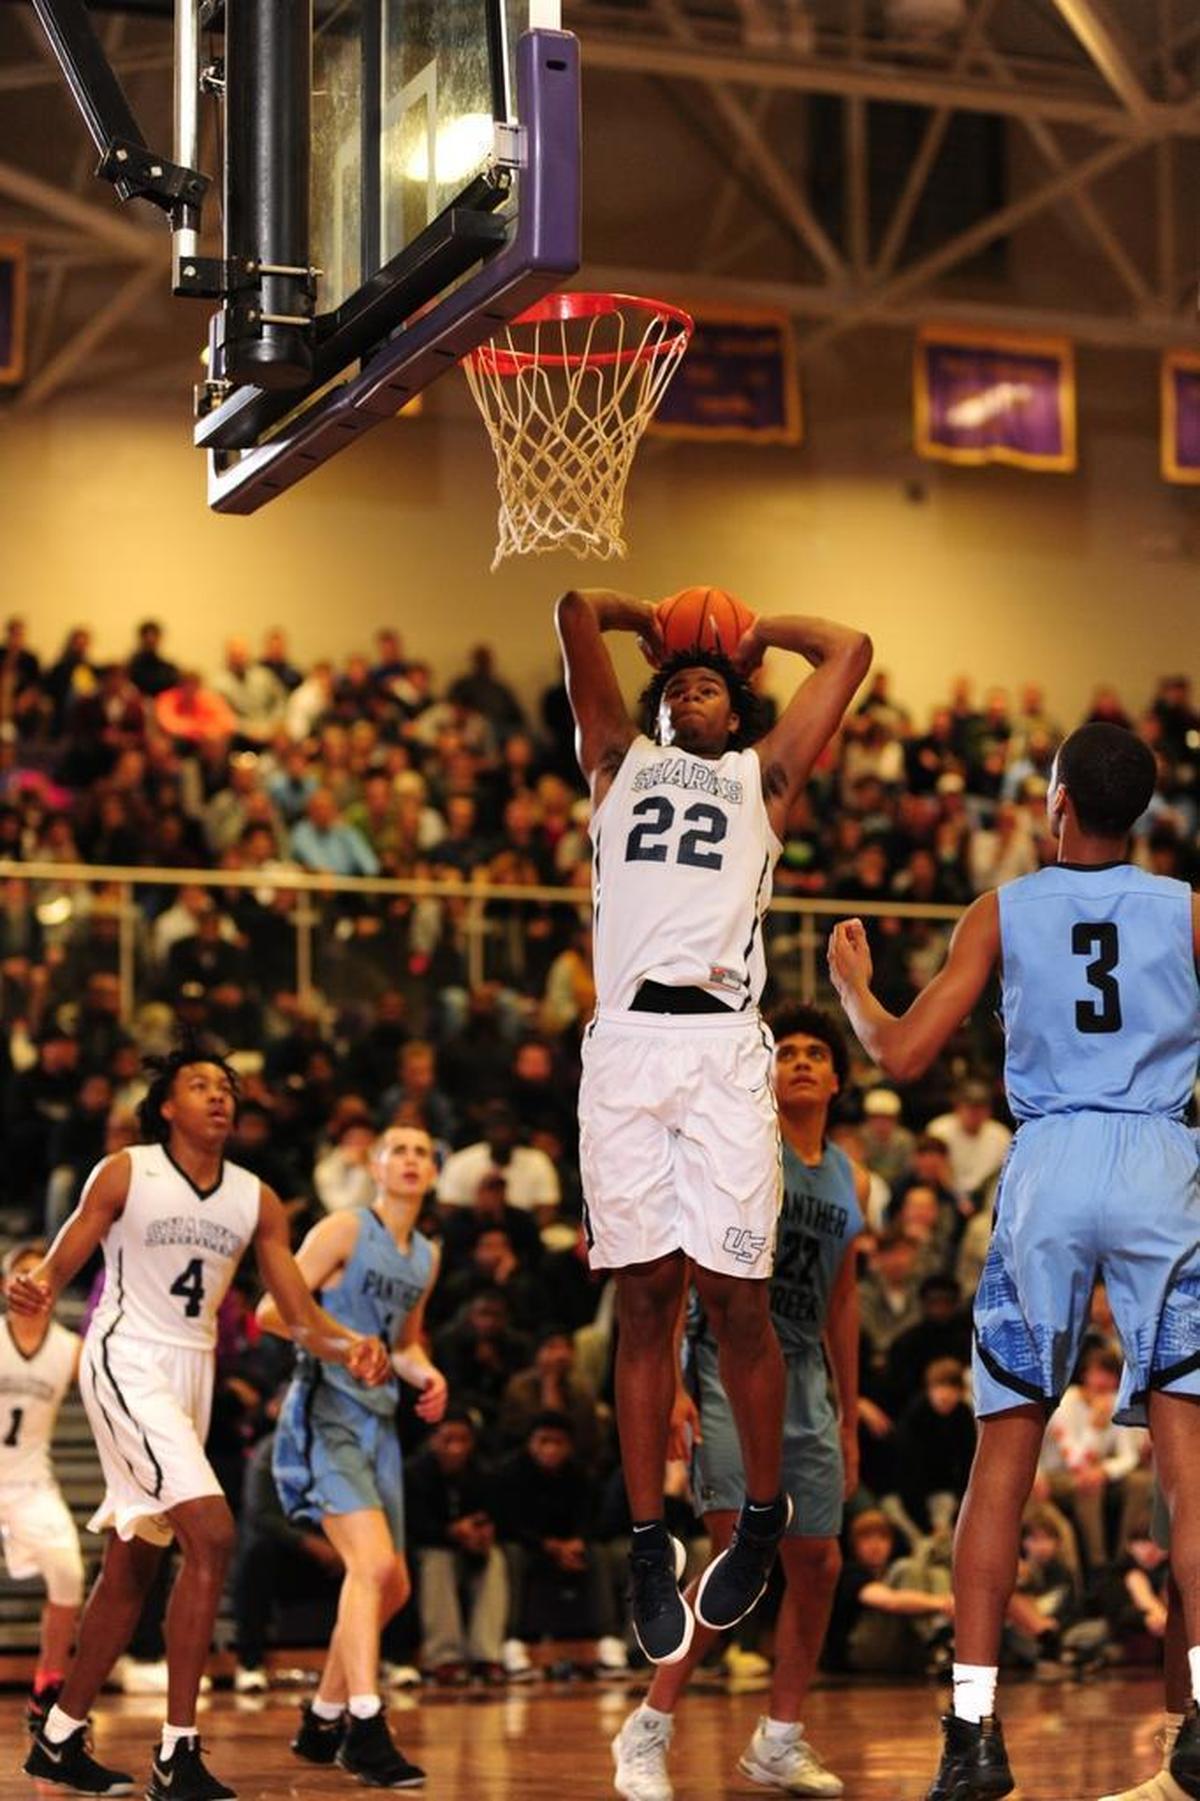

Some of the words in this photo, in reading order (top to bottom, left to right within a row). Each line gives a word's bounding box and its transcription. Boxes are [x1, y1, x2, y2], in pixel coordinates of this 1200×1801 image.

[631, 758, 744, 805] SHARKS
[625, 795, 728, 871] 22
[1071, 922, 1123, 1034] 3
[782, 1189, 848, 1239] ANTHER
[722, 1226, 767, 1265] US
[170, 1258, 205, 1318] 4
[773, 1284, 818, 1322] REEK
[3, 1407, 24, 1448] 1
